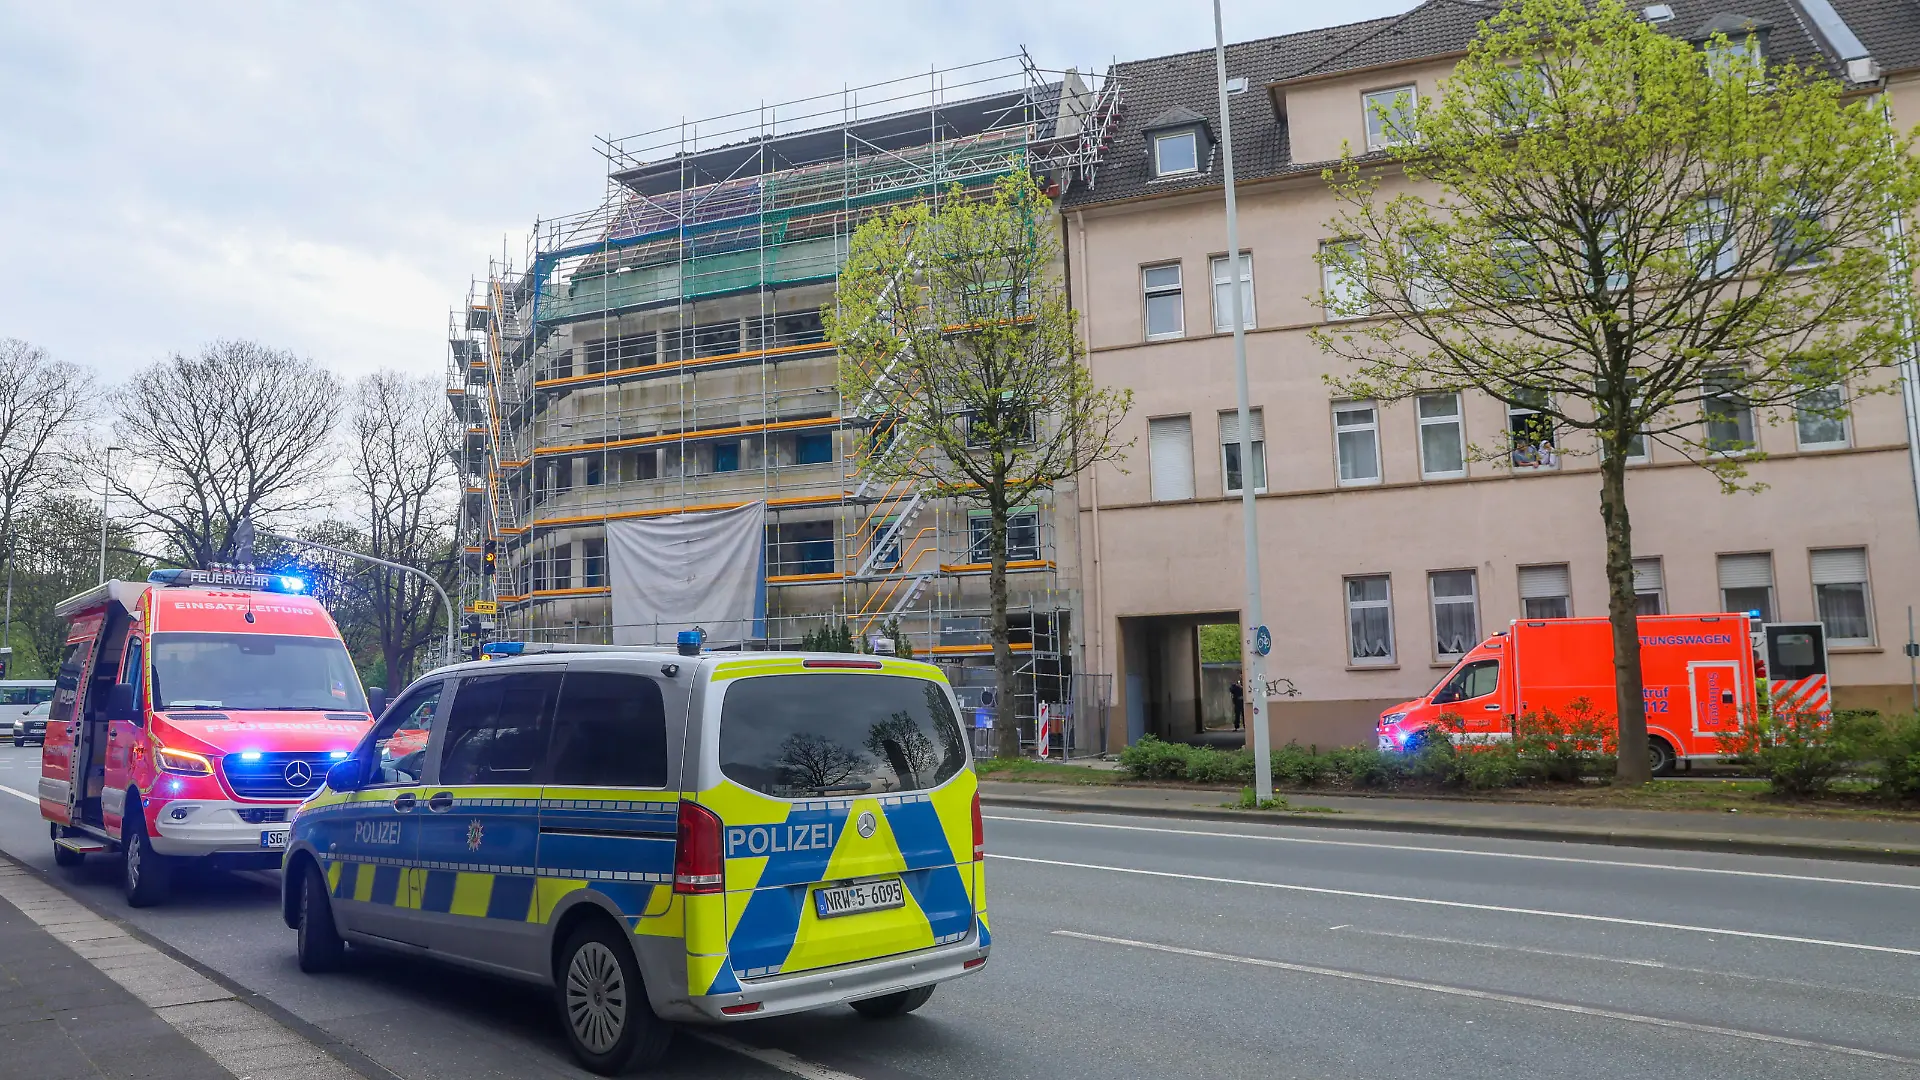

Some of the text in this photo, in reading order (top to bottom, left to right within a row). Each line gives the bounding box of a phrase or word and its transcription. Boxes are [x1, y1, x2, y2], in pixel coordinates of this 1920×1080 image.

[190, 572, 269, 587] FEUERWEHR
[174, 602, 314, 615] EINSATZLEITUNG
[1638, 634, 1731, 646] TUNGSWAGEN
[1643, 686, 1669, 698] truf
[1708, 672, 1719, 725] Solingen
[1643, 700, 1669, 713] 112
[205, 722, 360, 733] FEUERWEHR
[269, 833, 283, 844] SG
[354, 821, 401, 845] POLIZEI
[728, 823, 833, 856] POLIZEI
[824, 888, 850, 912] NRW
[856, 883, 901, 907] 5-6095
